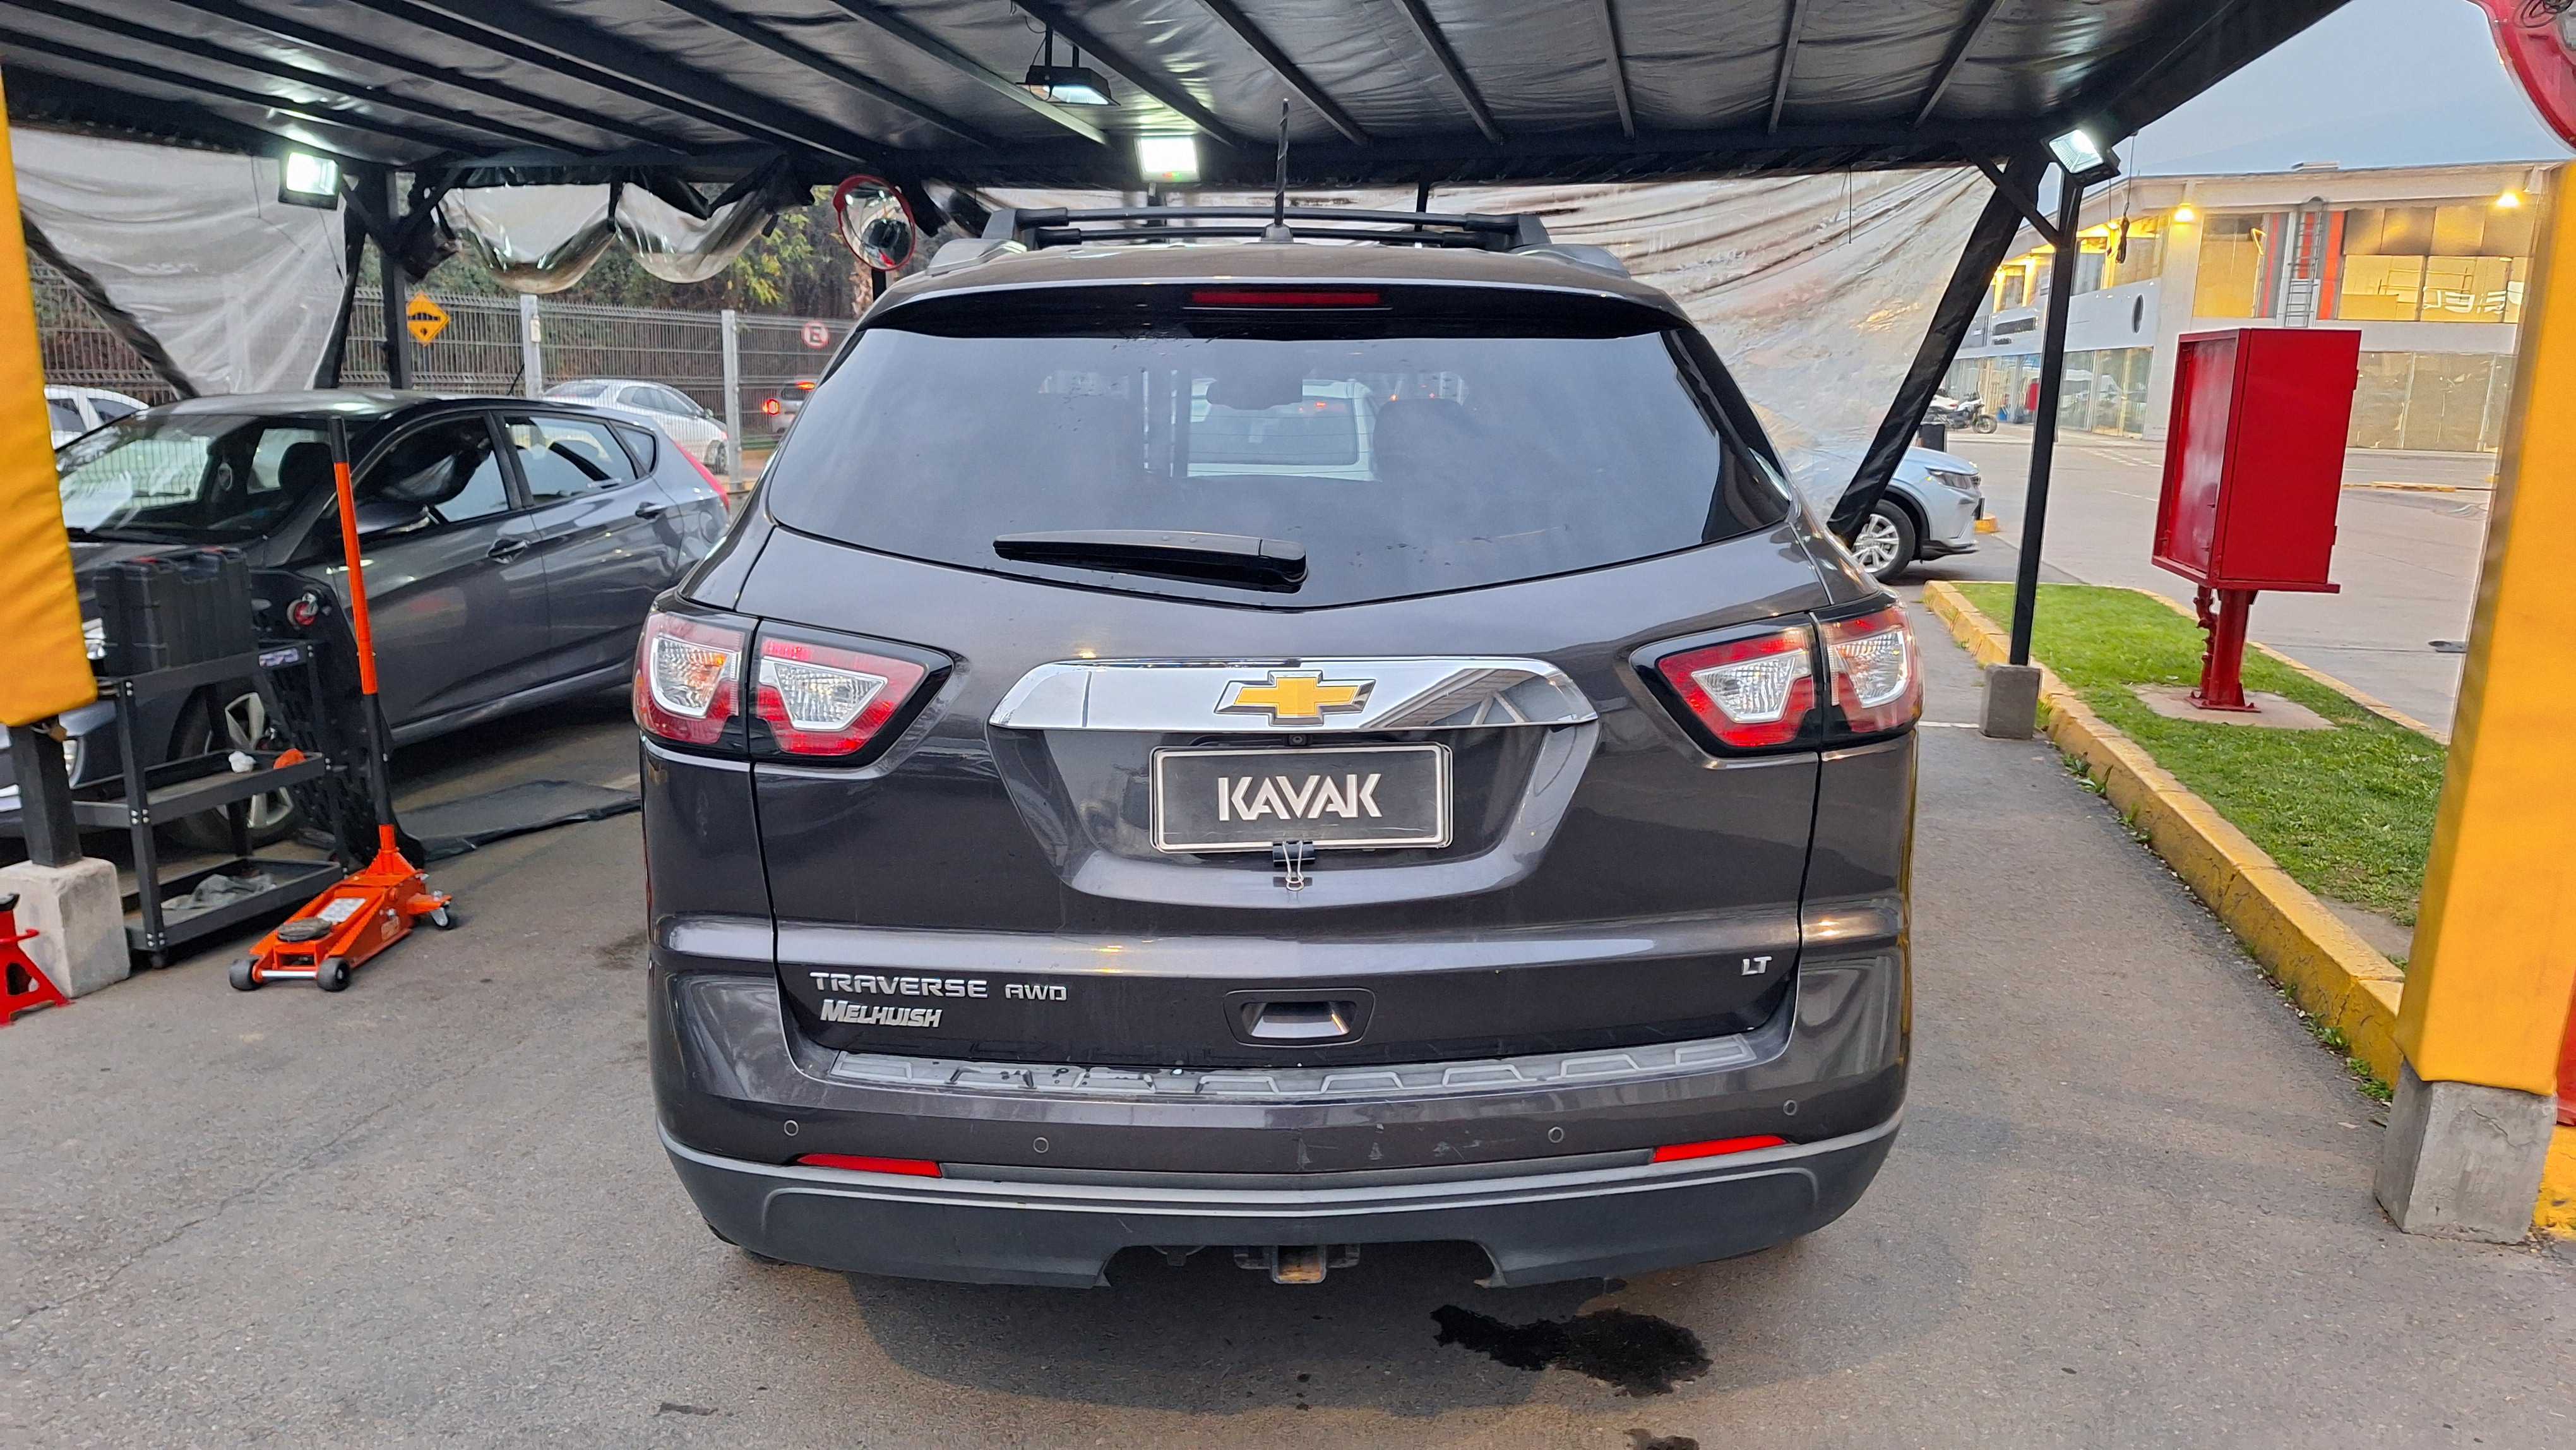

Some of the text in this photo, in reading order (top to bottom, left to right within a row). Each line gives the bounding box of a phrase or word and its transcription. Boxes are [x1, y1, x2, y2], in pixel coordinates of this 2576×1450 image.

[810, 326, 823, 343] E
[1218, 774, 1383, 821] KAVAK
[1741, 956, 1772, 975] LT
[809, 972, 1067, 1001] TRAVERSE AWD
[820, 998, 943, 1028] MELHUISH
